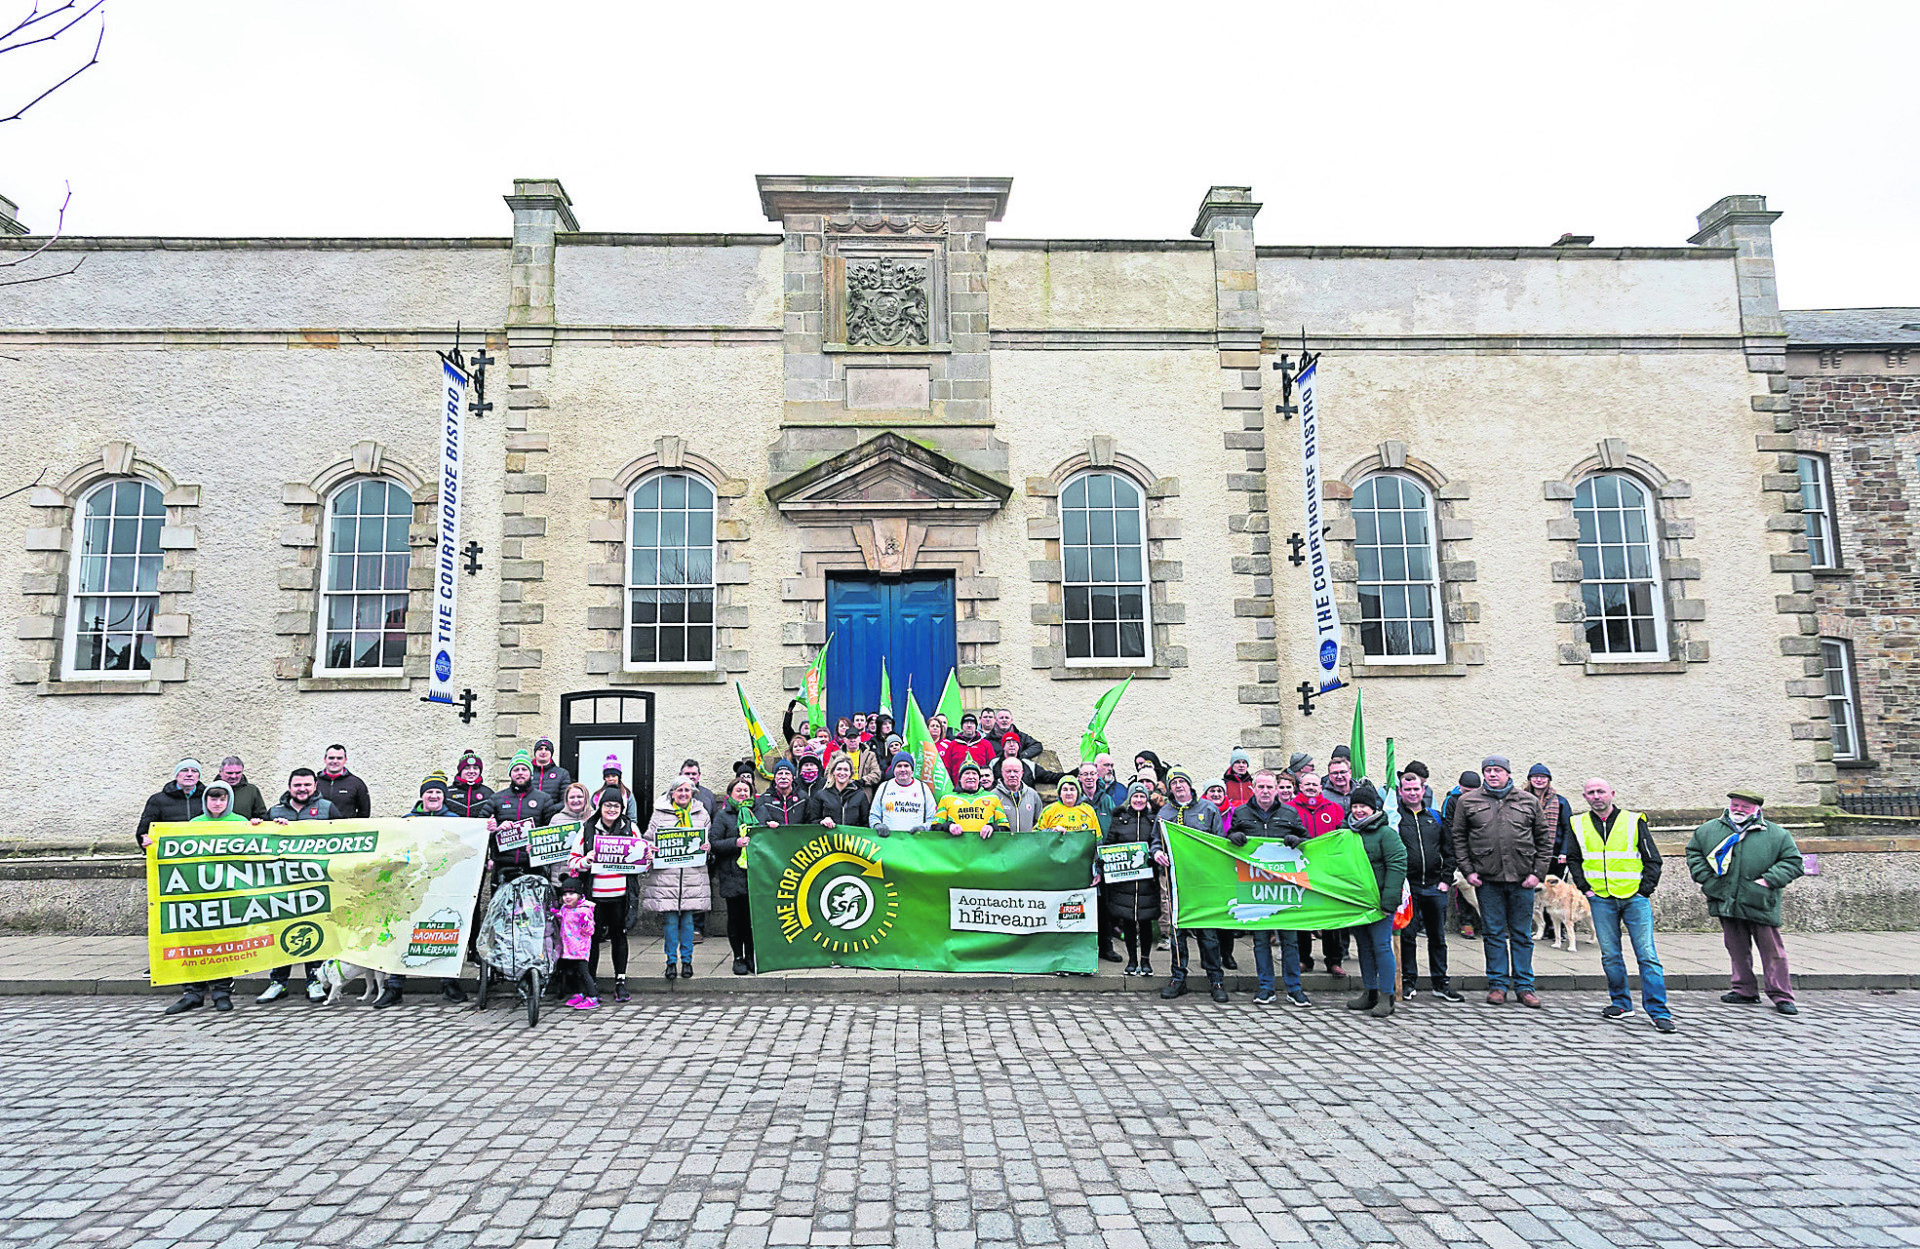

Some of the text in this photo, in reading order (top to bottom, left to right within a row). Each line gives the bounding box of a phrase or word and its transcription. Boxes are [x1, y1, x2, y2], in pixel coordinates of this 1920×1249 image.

[1302, 388, 1316, 460] BISTRO
[438, 387, 460, 642] THE COURTHOUSE BISTRO
[1306, 465, 1326, 592] COURTHOUSE
[1316, 596, 1334, 635] THE
[532, 834, 559, 846] IRISH
[657, 832, 686, 840] DONEGAL
[658, 838, 684, 848] IRISH
[164, 836, 374, 857] DONEGAL SUPPORTS
[533, 842, 562, 854] UNITY
[600, 844, 624, 854] IRISH
[658, 846, 687, 857] UNITY
[598, 854, 626, 862] UNITY
[1102, 852, 1128, 862] IRISH
[1104, 860, 1132, 872] UNITY
[1268, 864, 1287, 872] FOR
[166, 860, 326, 892] A UNITED
[777, 834, 882, 944] TIME FOR IRISH UNITY
[1252, 884, 1306, 902] UNITY
[168, 890, 325, 930] IRELAND
[958, 895, 1046, 909] Aontacht na
[958, 907, 1047, 928] hÉireann
[168, 937, 268, 958] #Time4Unity
[181, 951, 258, 967] Am d'Aontacht
